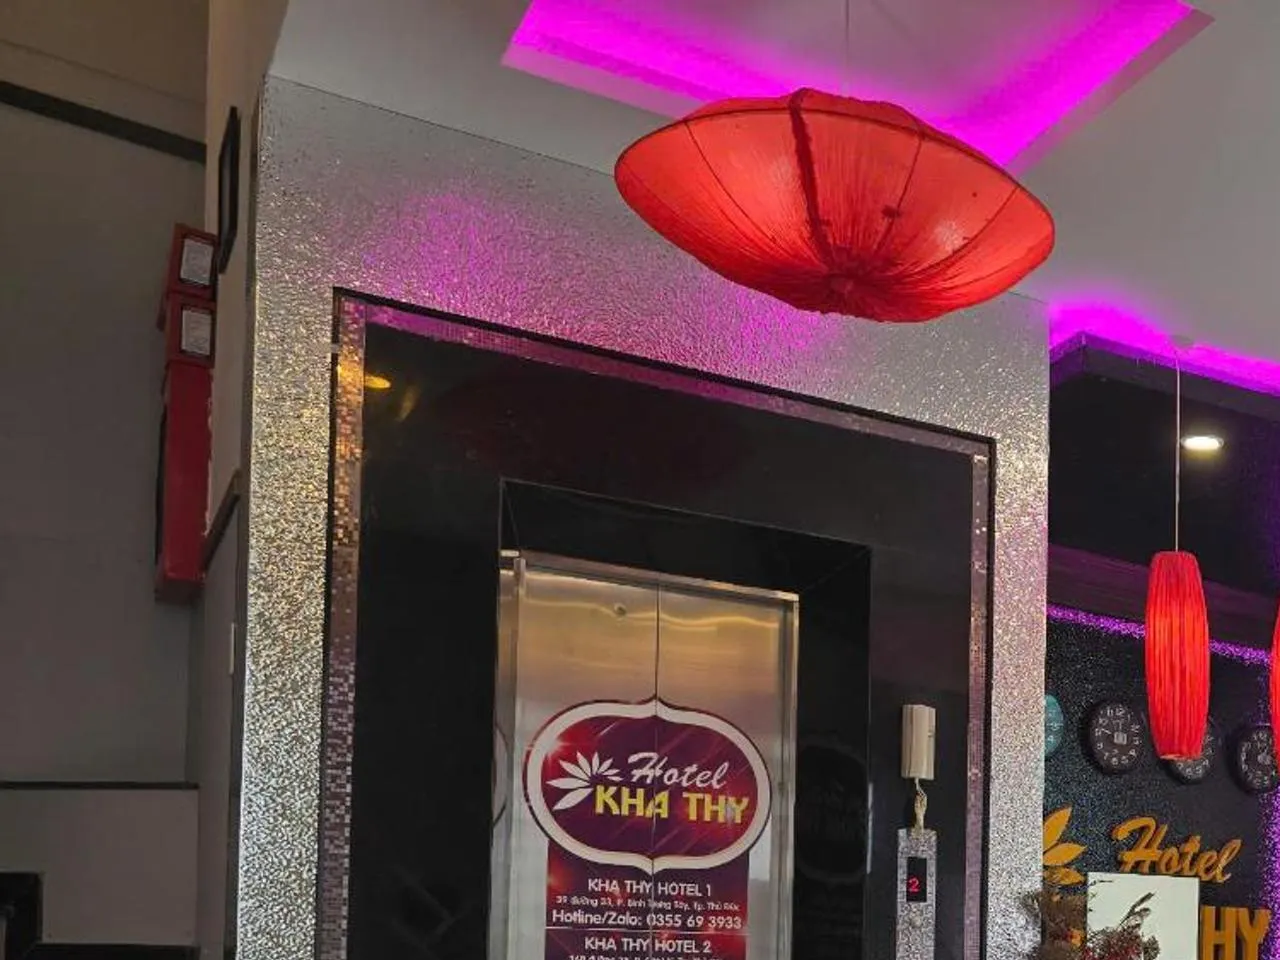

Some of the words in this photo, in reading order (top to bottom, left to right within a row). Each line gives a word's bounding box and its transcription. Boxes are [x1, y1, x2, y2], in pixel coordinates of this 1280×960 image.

[628, 752, 729, 789] Hotel
[595, 785, 669, 818] KHA
[682, 792, 749, 823] THY
[1111, 816, 1242, 883] Hotel
[588, 879, 620, 894] KHA
[625, 880, 652, 894] THY
[658, 883, 702, 896] HOTEL
[706, 884, 711, 897] 1
[907, 877, 920, 892] 2
[552, 909, 642, 926] Hotline/Zalo:
[647, 913, 681, 926] 0355
[687, 915, 704, 928] 69
[708, 916, 742, 929] 3933
[585, 937, 617, 950] KHA
[622, 937, 650, 951] THY
[655, 939, 699, 953] HOTEL
[703, 940, 712, 953] 2
